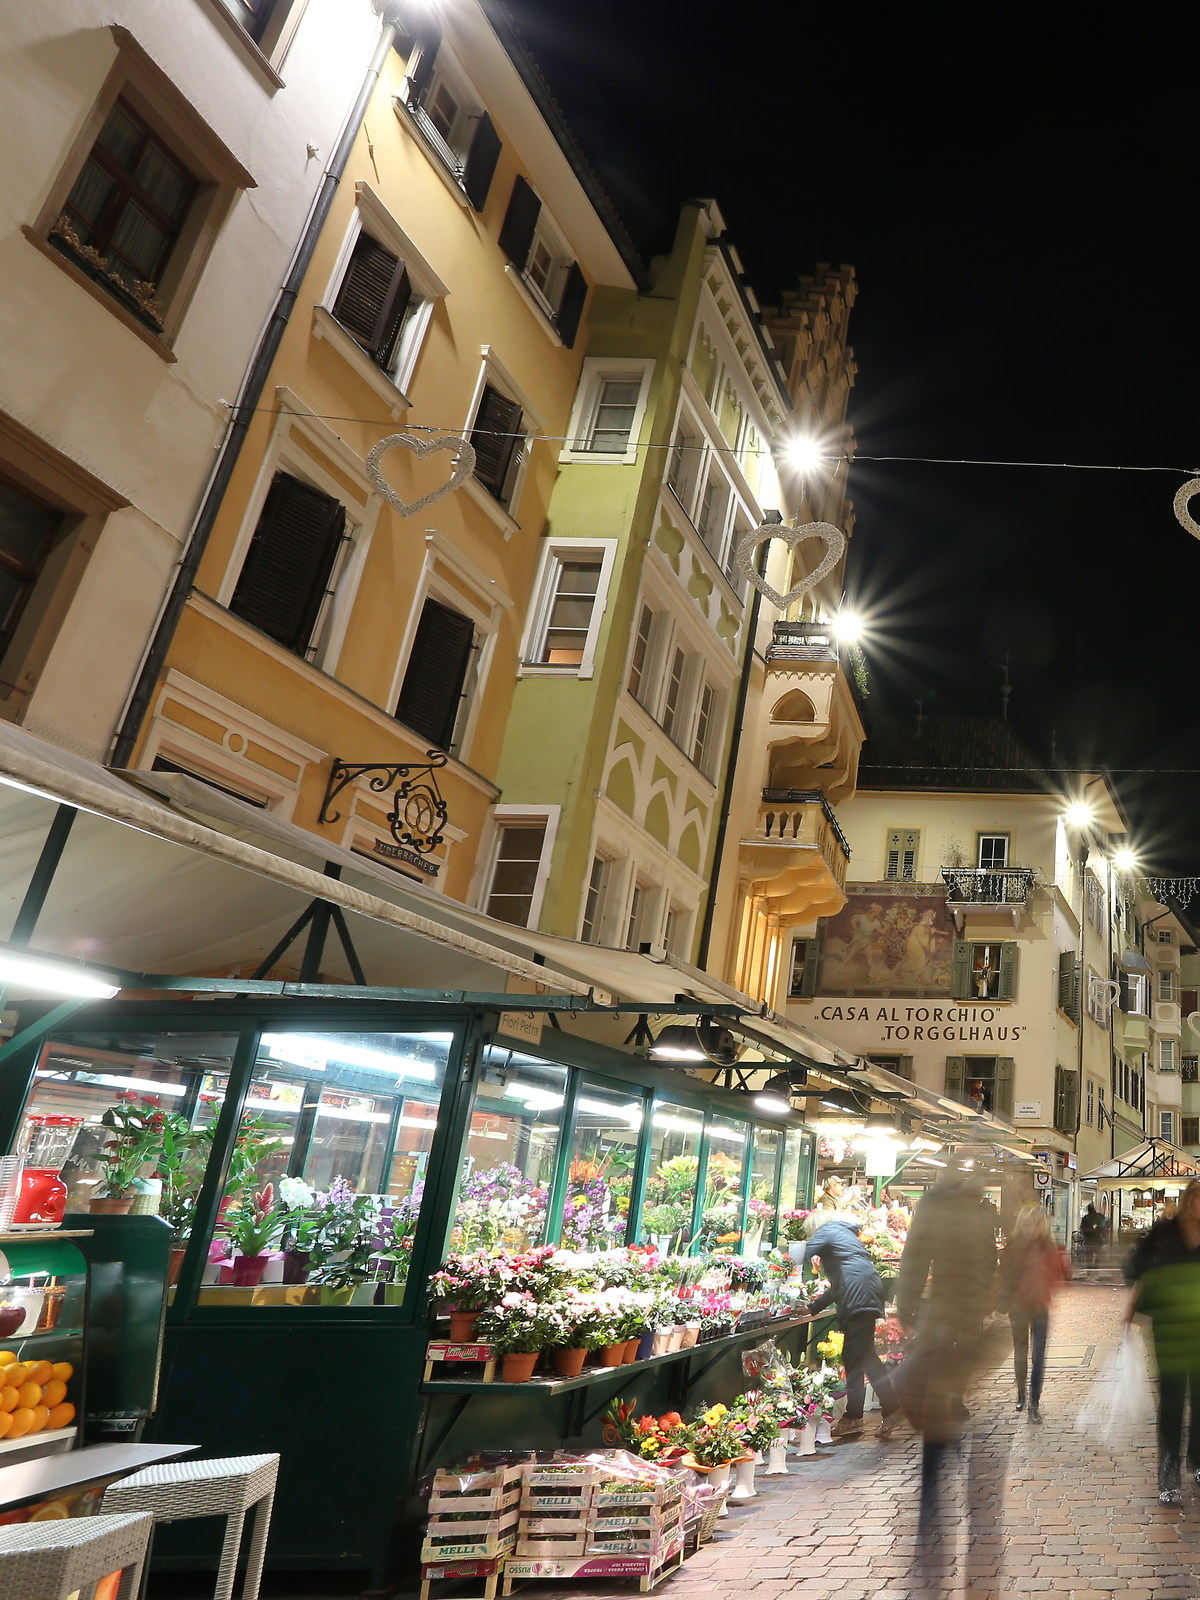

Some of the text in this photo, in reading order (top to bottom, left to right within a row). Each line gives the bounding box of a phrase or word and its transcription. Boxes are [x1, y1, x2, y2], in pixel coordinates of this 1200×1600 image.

[876, 1007, 900, 1022] AL
[502, 1014, 520, 1029] Fiori
[520, 1020, 539, 1036] Petra
[536, 1497, 572, 1505] MELLI
[439, 1546, 475, 1555] MELLI
